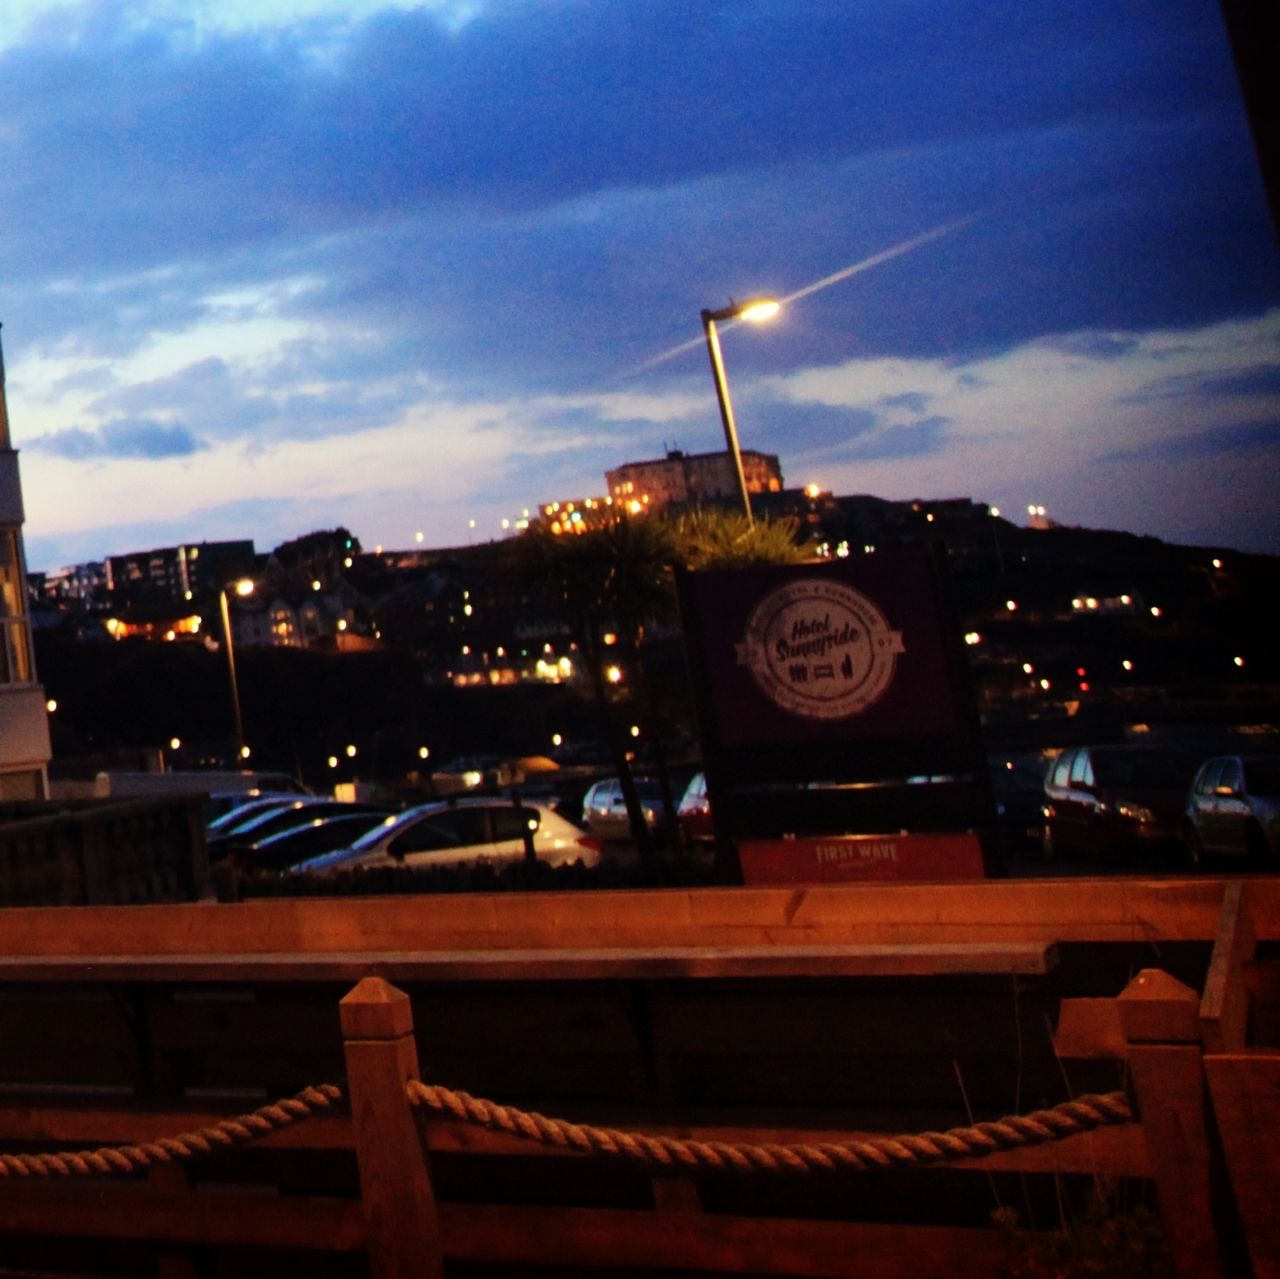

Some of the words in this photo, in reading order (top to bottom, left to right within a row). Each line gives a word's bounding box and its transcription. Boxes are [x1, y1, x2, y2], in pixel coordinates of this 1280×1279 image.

[792, 613, 830, 641] Hotel
[775, 622, 860, 661] Sunnyside
[816, 844, 853, 863] FIRST
[857, 842, 898, 861] WAVE
